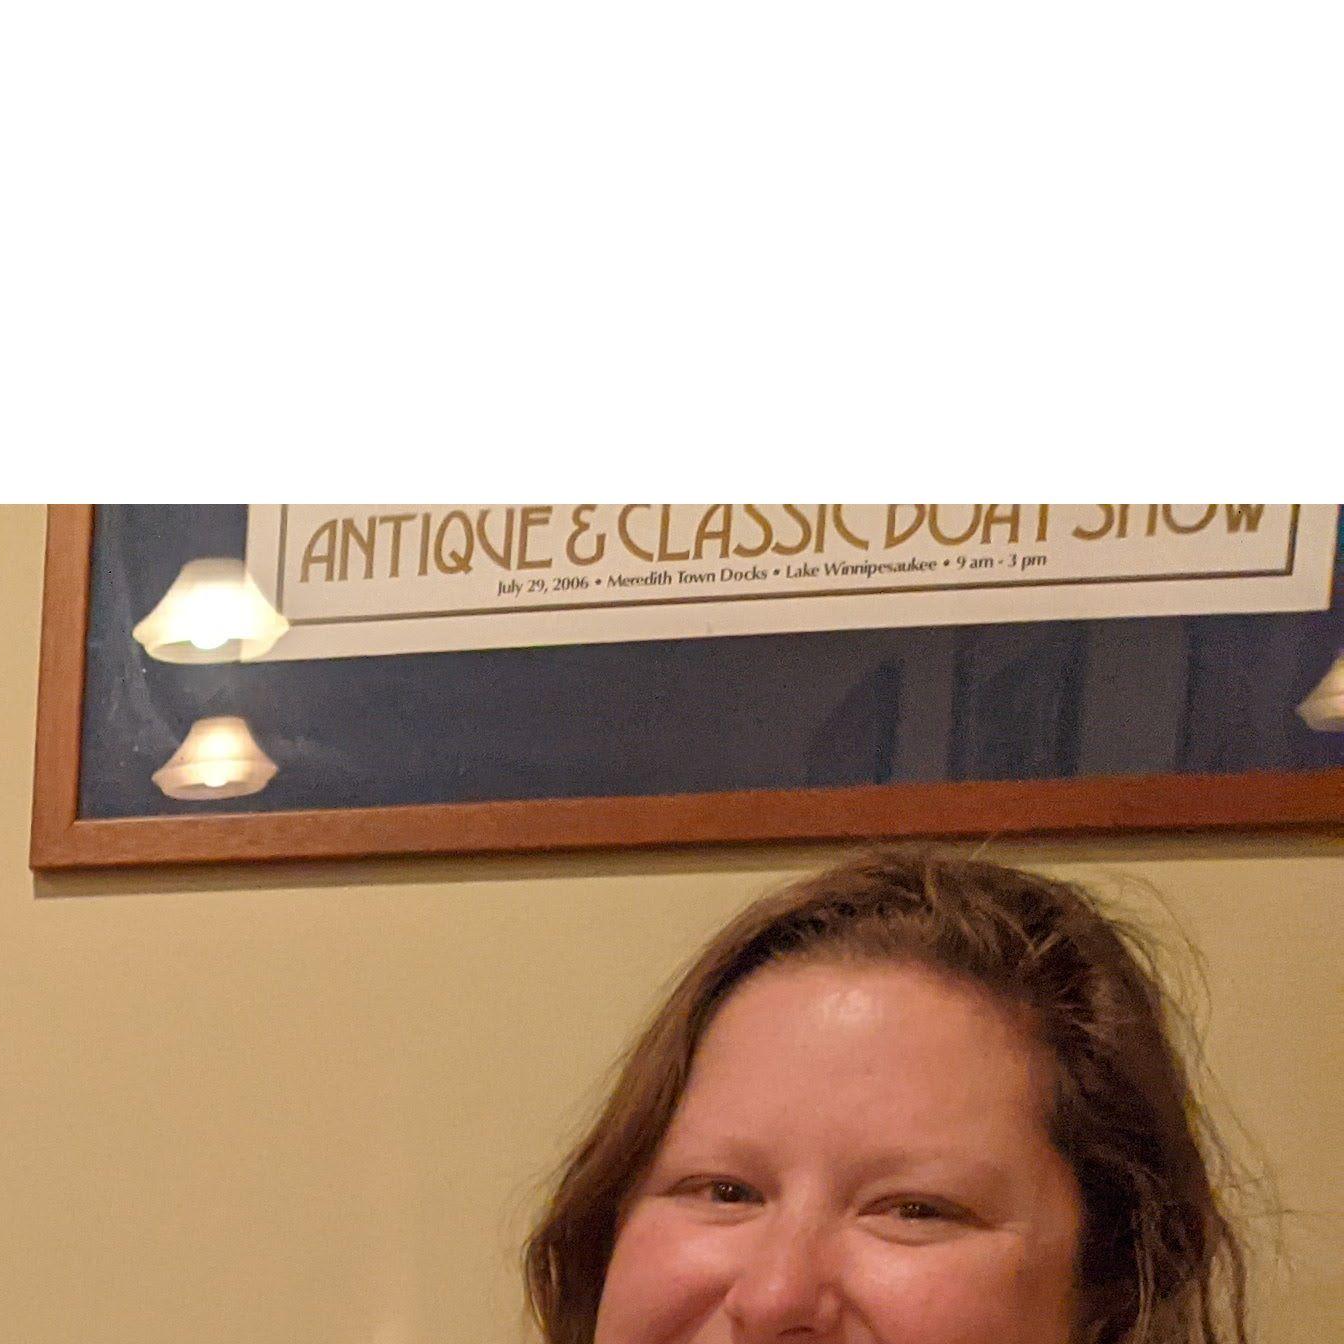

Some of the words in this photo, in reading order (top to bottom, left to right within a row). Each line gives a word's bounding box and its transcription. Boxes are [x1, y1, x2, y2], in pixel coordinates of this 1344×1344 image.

[299, 506, 552, 582] ANTIQUE
[565, 504, 607, 566] &
[618, 504, 869, 562] CLASSIC
[497, 579, 523, 598] July
[527, 578, 549, 594] 29,
[552, 576, 590, 592] 2006
[607, 570, 673, 588] Meredith
[677, 569, 716, 585] Town
[720, 566, 768, 582] Docks
[786, 563, 820, 579] Lake
[824, 557, 938, 578] Winnipesaukee
[955, 556, 967, 570] 9
[969, 557, 994, 570] am
[1007, 553, 1018, 568] 3
[1019, 554, 1048, 571] pm
